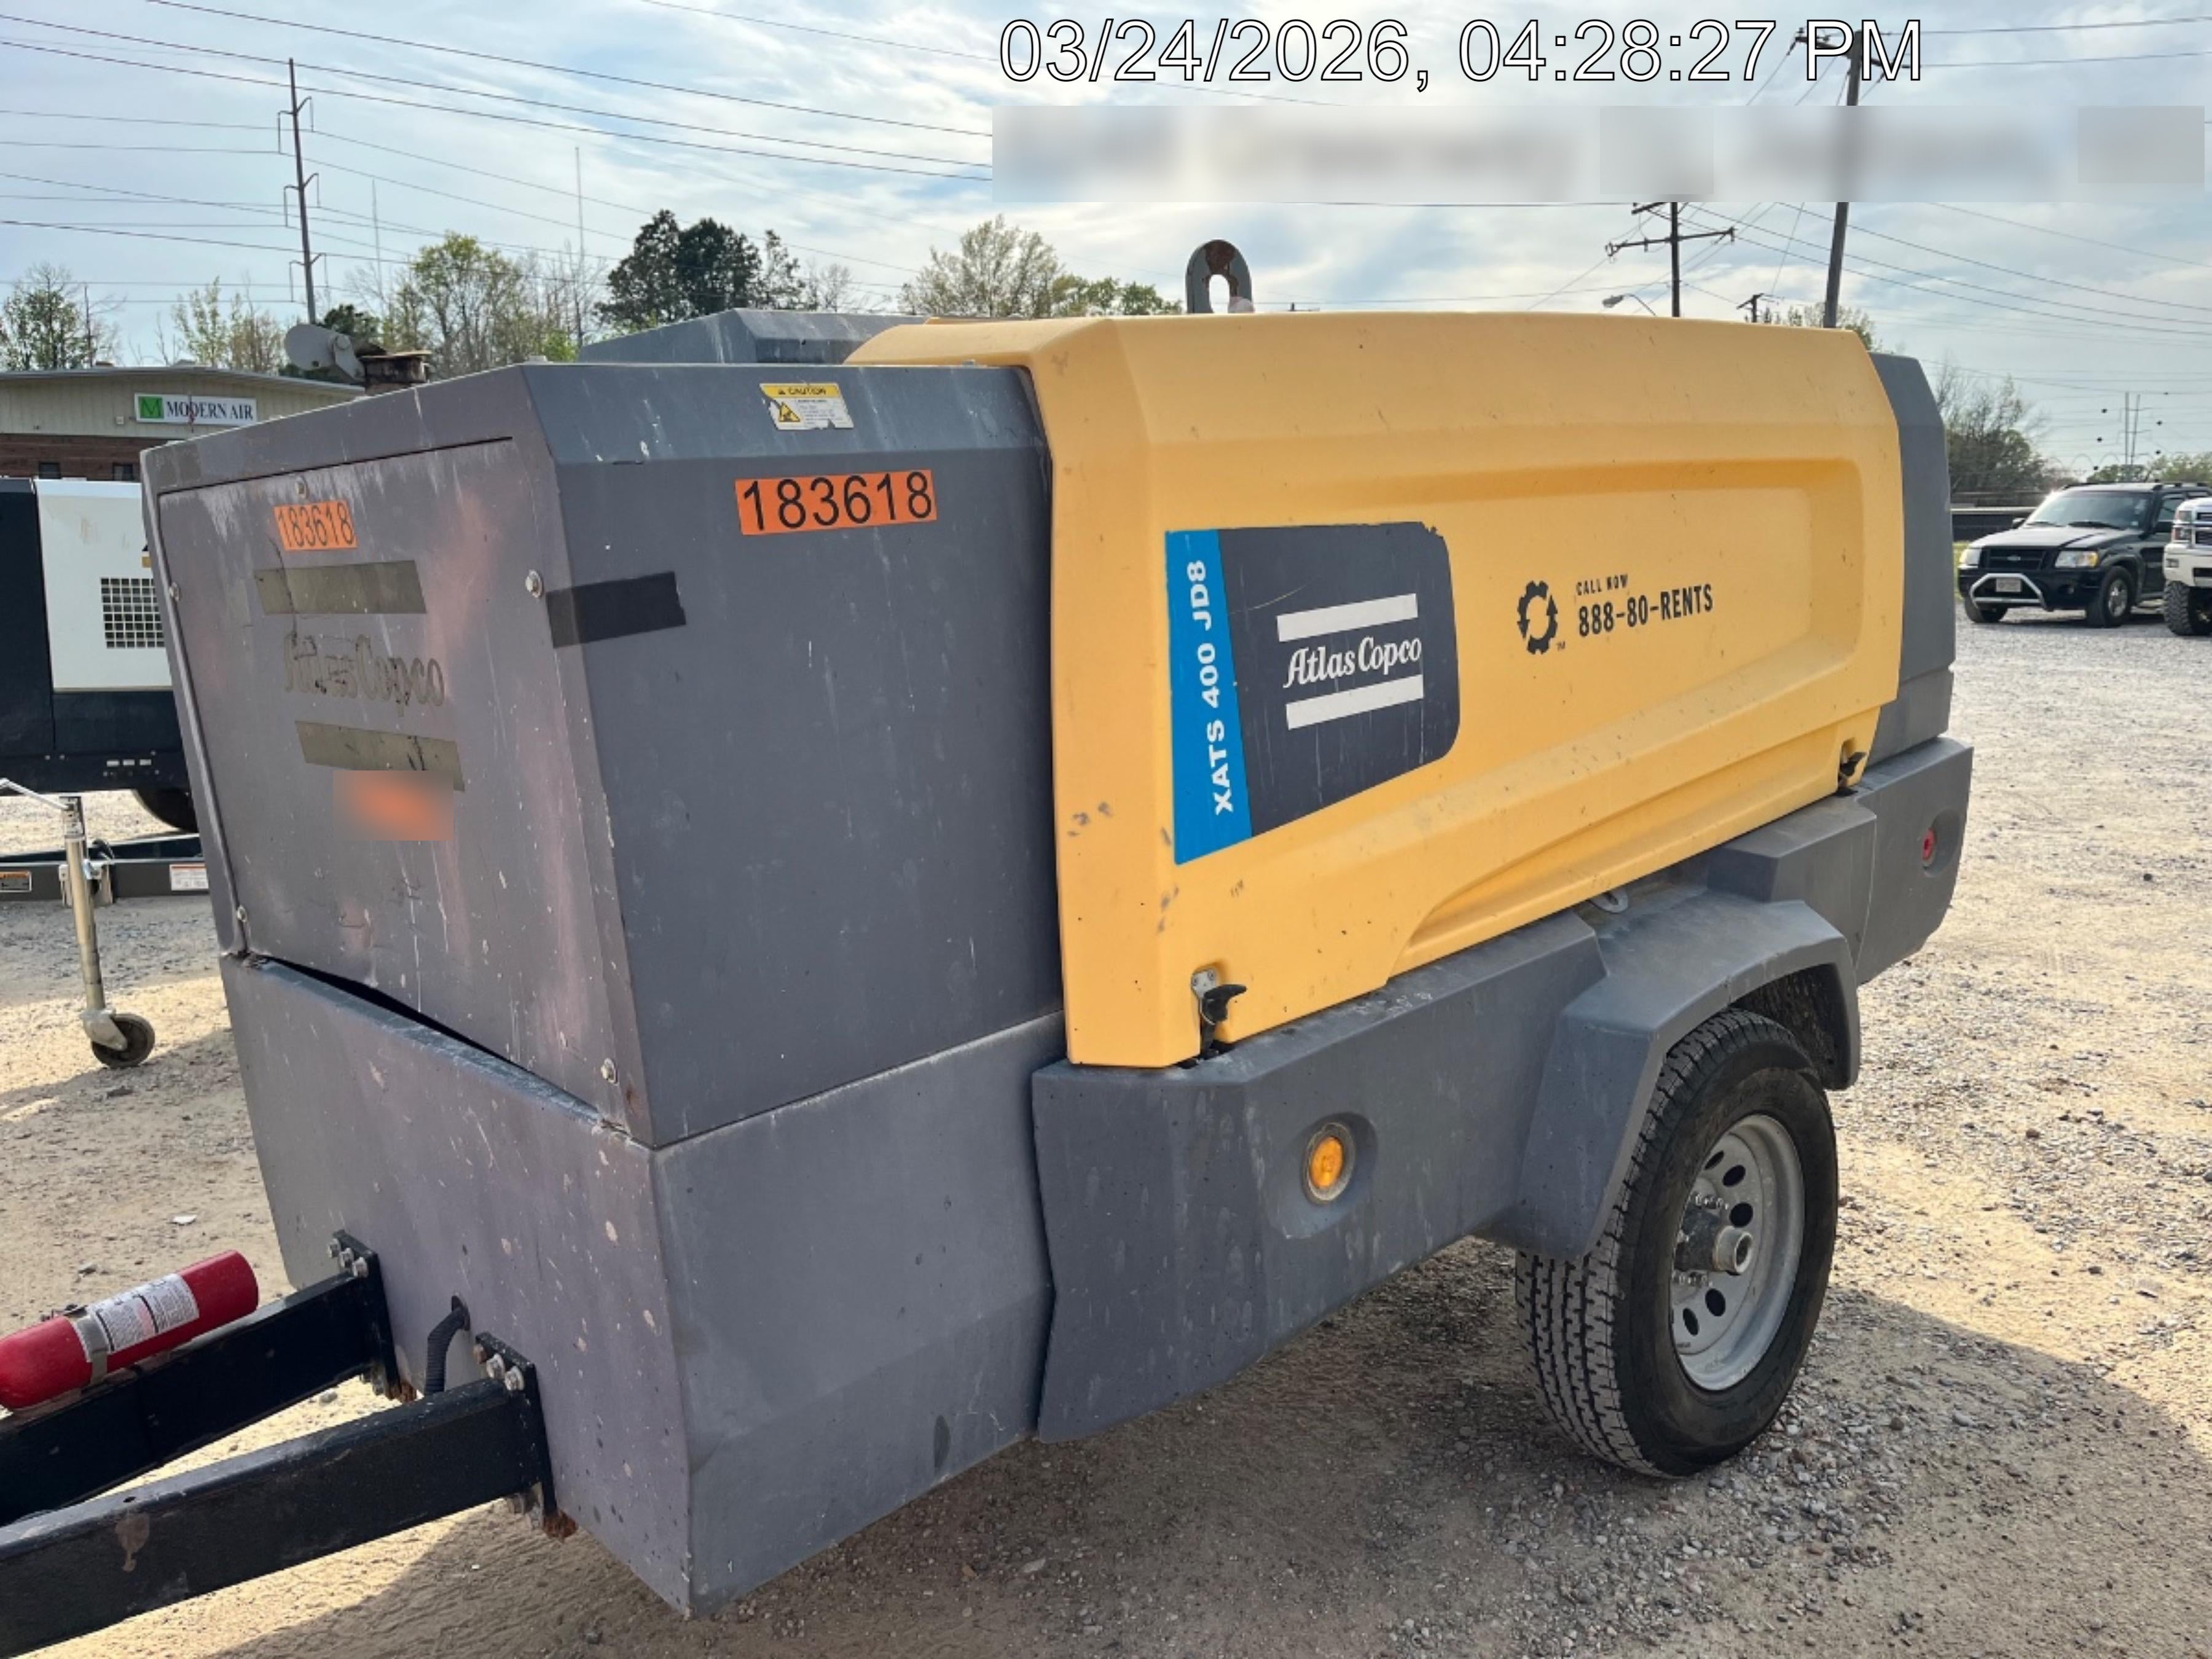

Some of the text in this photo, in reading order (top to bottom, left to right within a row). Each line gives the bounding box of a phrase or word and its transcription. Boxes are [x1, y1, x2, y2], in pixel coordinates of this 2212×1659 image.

[167, 401, 253, 420] MODERN AIR
[278, 502, 353, 548] 183618
[743, 471, 931, 530] 183618
[1576, 574, 1628, 596] CALL NOW
[1579, 583, 1714, 637] 888-80-RENTS
[1186, 560, 1234, 816] XATS 400 JD8
[1282, 635, 1422, 689] Atlas Copco
